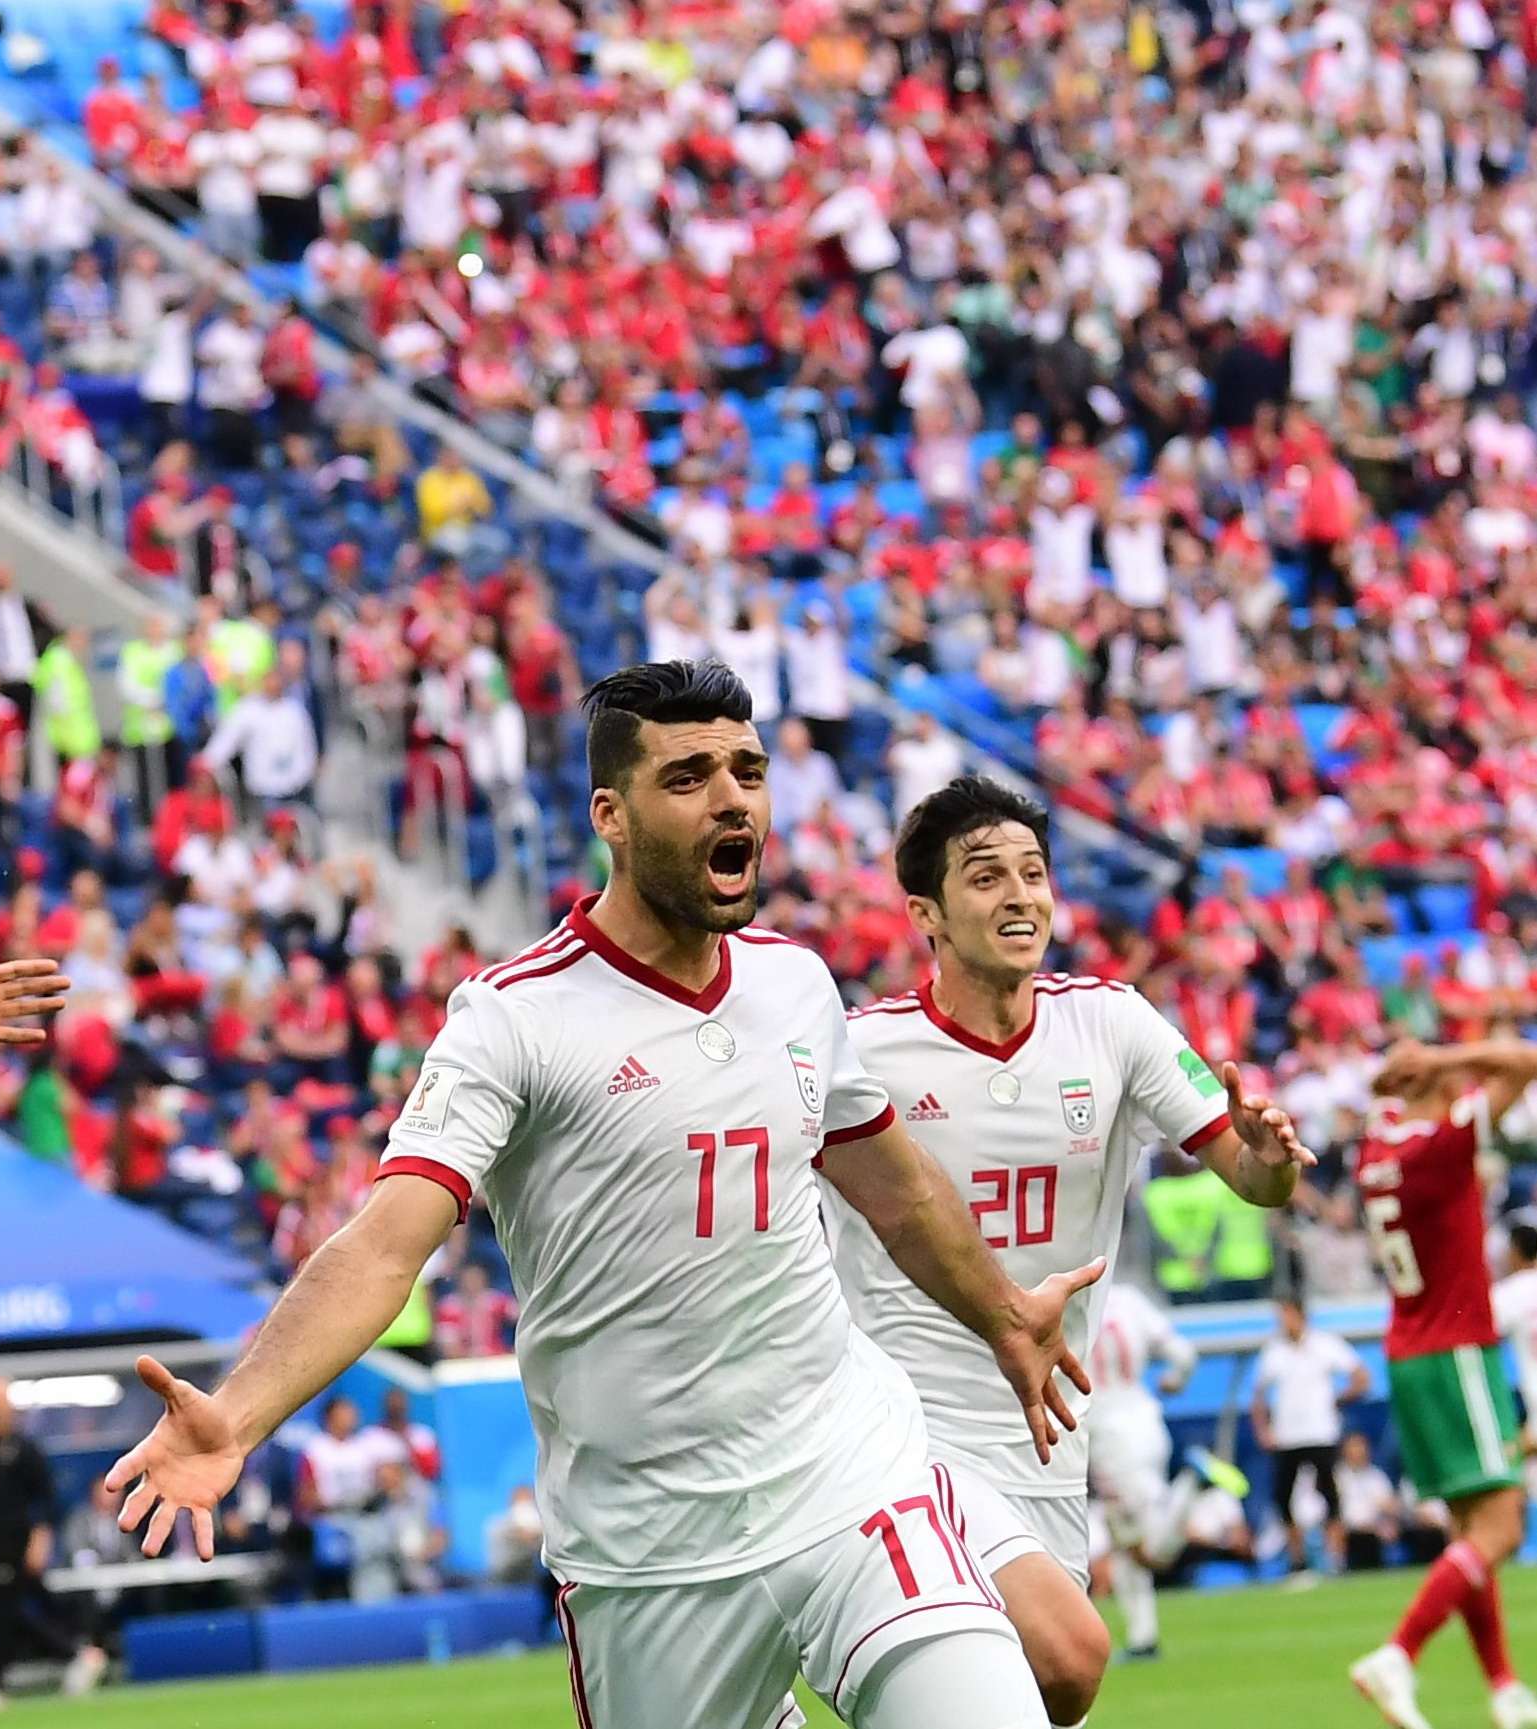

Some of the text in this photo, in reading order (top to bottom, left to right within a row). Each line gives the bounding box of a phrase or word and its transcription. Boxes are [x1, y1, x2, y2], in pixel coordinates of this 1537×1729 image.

[607, 1076, 661, 1095] adidas
[905, 1110, 950, 1121] adidas
[687, 1126, 769, 1238] 17
[969, 1165, 1058, 1249] 20
[859, 1494, 966, 1600] 17
